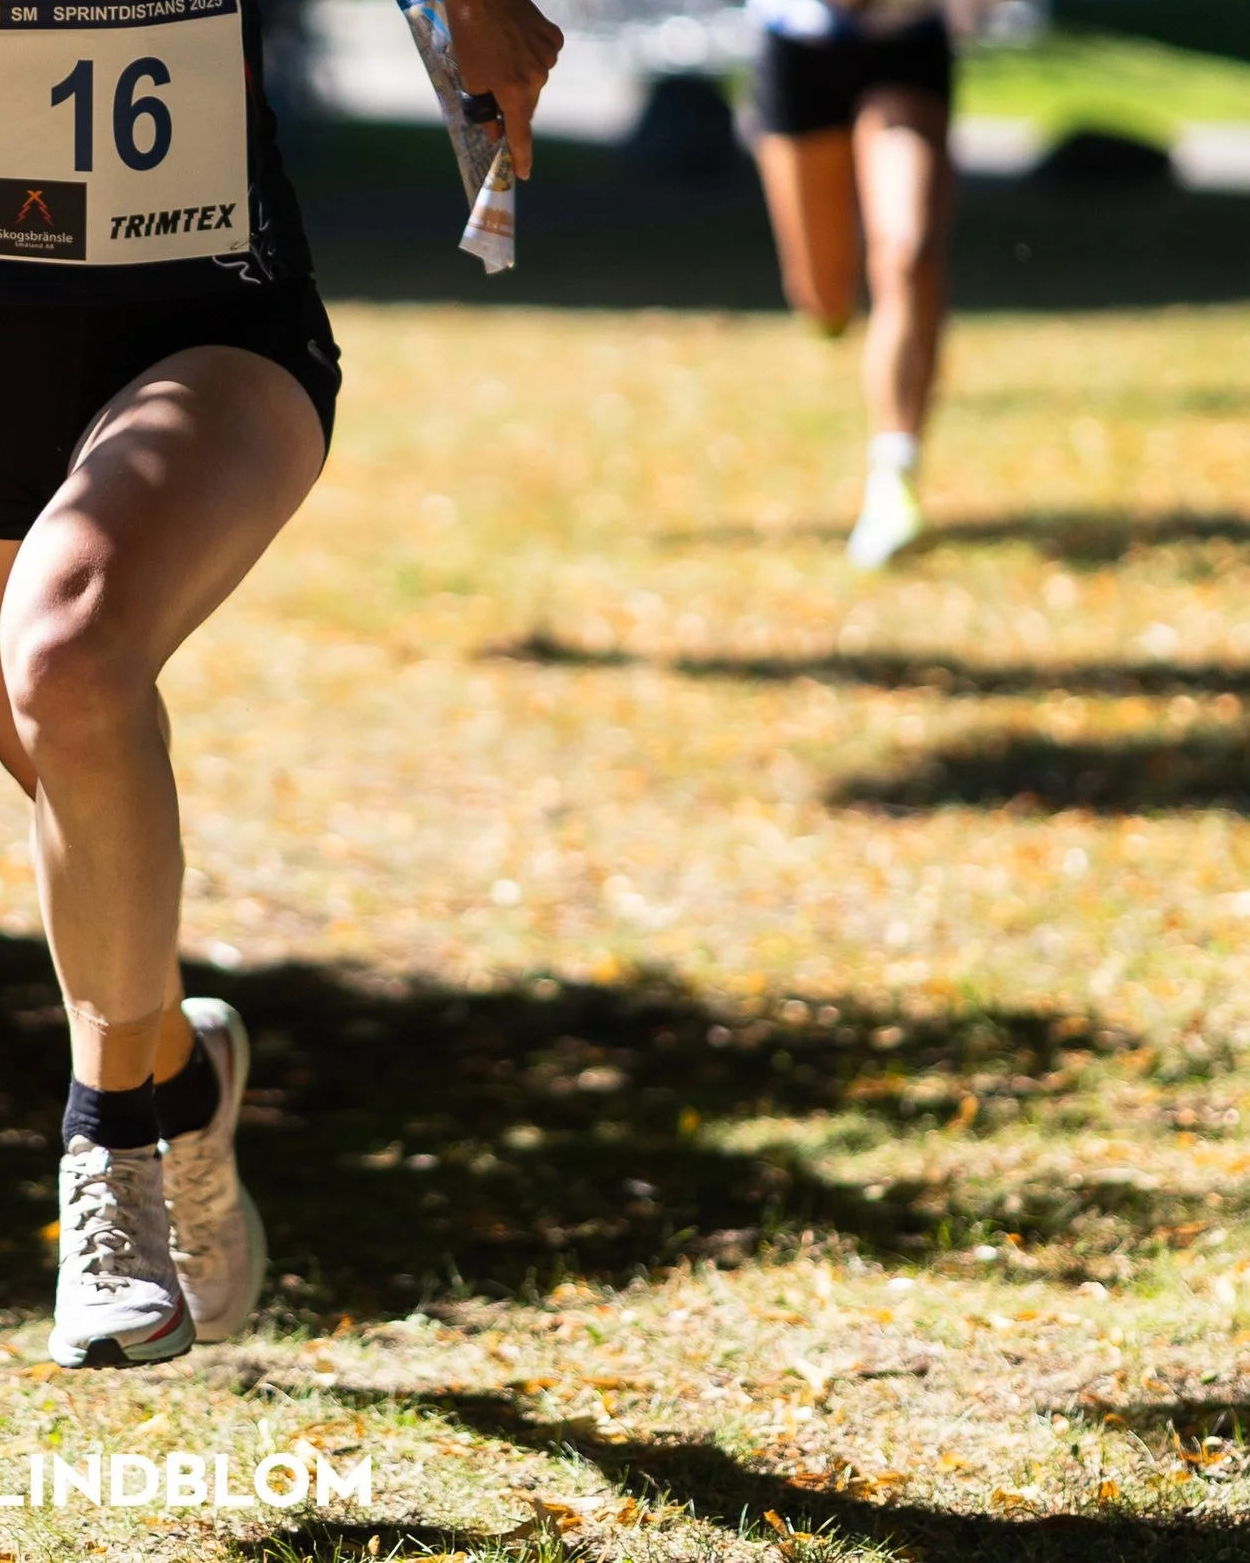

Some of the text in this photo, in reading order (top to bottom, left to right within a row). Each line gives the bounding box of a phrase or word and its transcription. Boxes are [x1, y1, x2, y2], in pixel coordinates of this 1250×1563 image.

[11, 7, 39, 22] SM
[50, 56, 172, 172] 16
[109, 203, 237, 240] TRIMTEX
